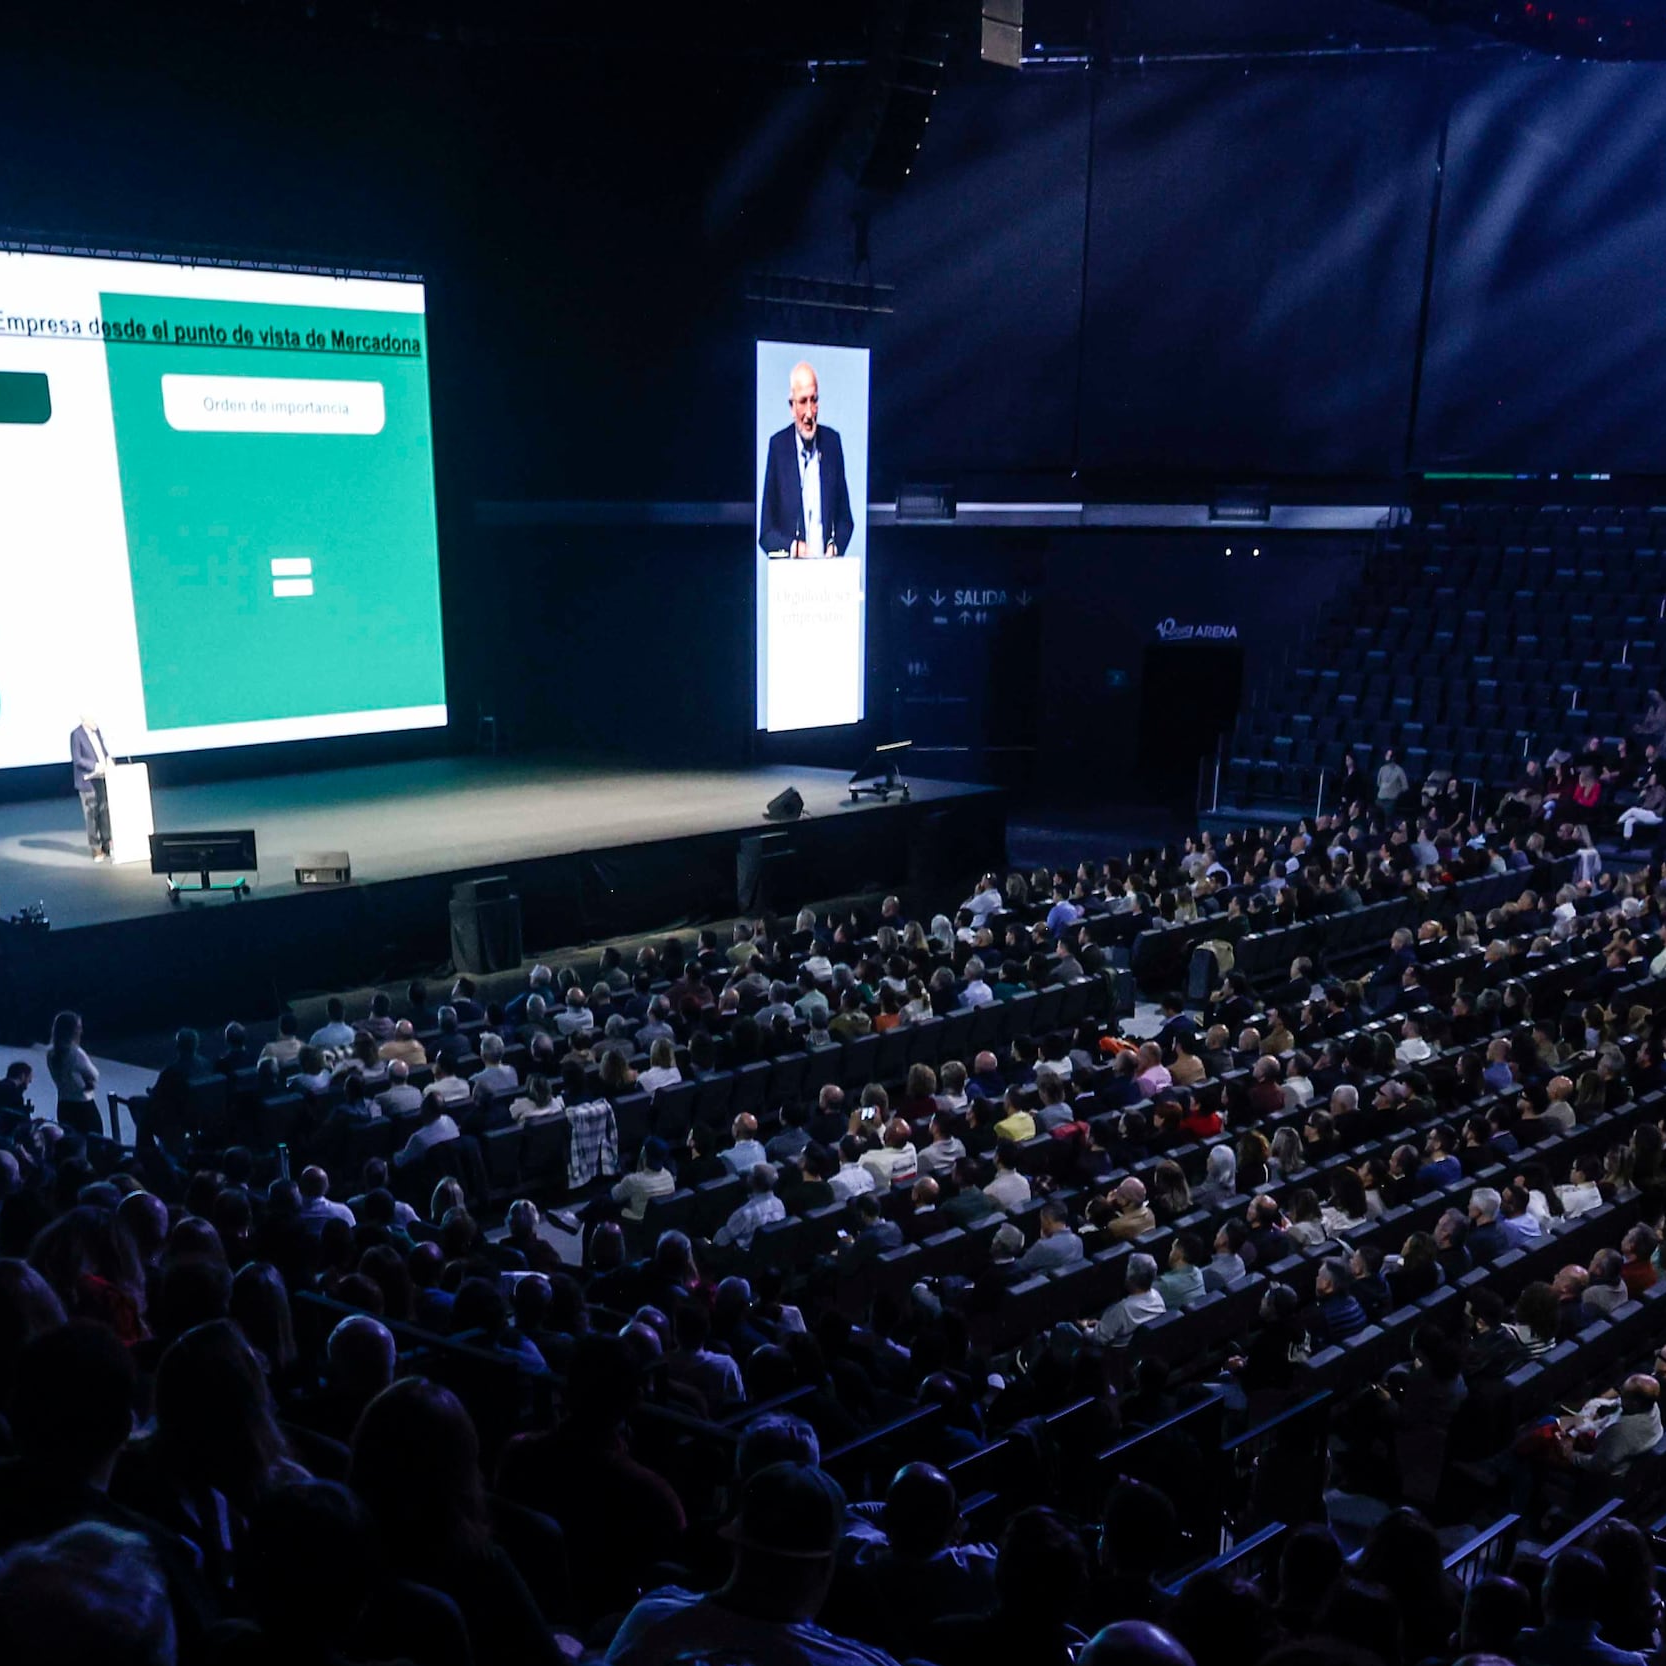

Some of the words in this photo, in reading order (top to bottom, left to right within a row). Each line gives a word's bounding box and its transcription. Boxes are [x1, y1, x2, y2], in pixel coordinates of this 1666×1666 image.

[89, 316, 146, 339] desde
[152, 320, 169, 341] el
[174, 323, 227, 345] punto
[232, 326, 254, 346] de
[259, 326, 301, 347] vista
[306, 328, 326, 349] de
[332, 329, 421, 353] Mercadona
[203, 396, 246, 413] Orden
[251, 399, 267, 413] de
[271, 401, 350, 416] importancia
[953, 588, 1009, 607] SALIDA
[1194, 624, 1238, 640] ARENA
